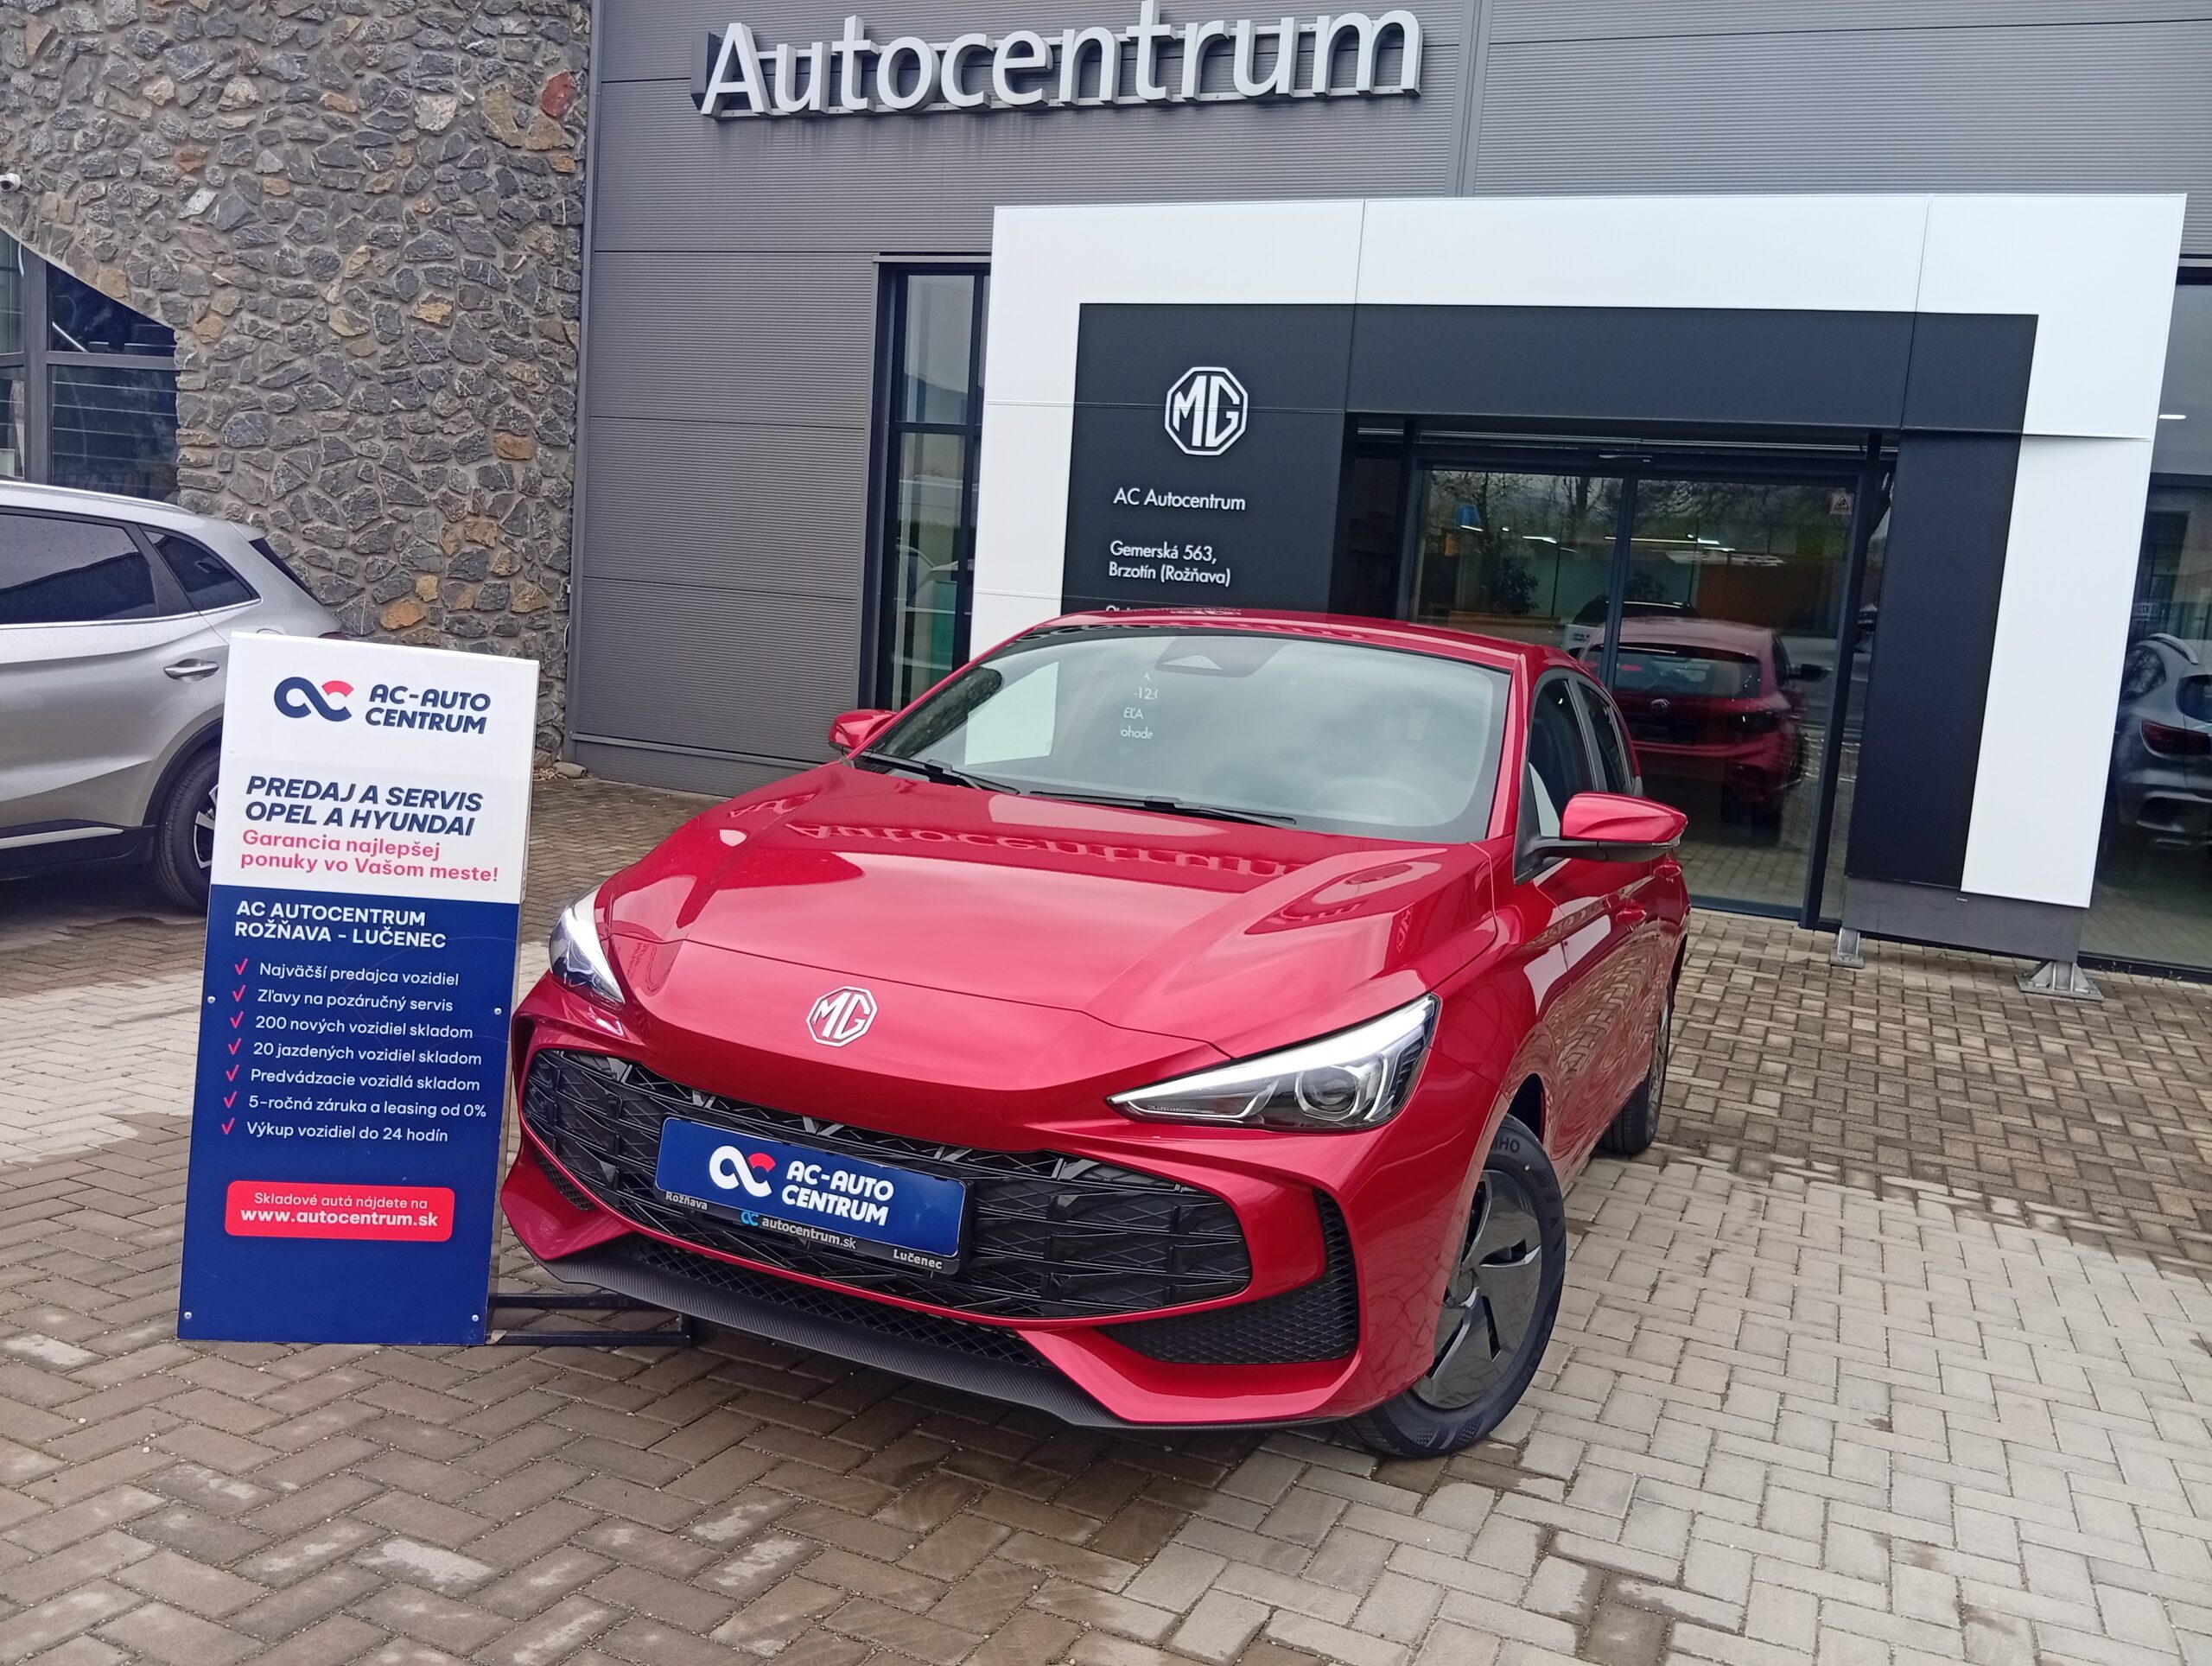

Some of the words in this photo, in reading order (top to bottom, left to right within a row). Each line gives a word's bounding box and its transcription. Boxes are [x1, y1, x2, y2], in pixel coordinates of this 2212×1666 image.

[700, 0, 1422, 117] Autocentrum
[1165, 366, 1249, 455] MG
[1113, 487, 1141, 506] AC
[1143, 489, 1246, 511] Autocentrum
[1109, 541, 1179, 560] Gemerská
[1182, 545, 1217, 564] 563,
[1109, 563, 1156, 580] Brzotín
[1160, 564, 1231, 588] (Rožňava)
[370, 684, 491, 712] AC-AUTO
[365, 707, 487, 734] CENTRUM
[246, 775, 357, 803] PREDAJ
[359, 785, 378, 804] A
[386, 786, 484, 811] SERVIS
[245, 802, 317, 825] OPEL
[324, 808, 343, 827] A
[350, 810, 475, 836] HYUNDAI
[242, 830, 341, 852] Garancia
[346, 839, 441, 861] najlepšej
[240, 855, 318, 873] ponuky
[324, 860, 347, 872] vo
[354, 857, 424, 877] Vašom
[430, 867, 499, 881] meste!
[237, 900, 266, 918] AC
[270, 903, 426, 926] AUTOCENTRUM
[235, 918, 332, 942] ROŽŇAVA
[353, 925, 446, 949] LUČENEC
[259, 962, 327, 982] Najväčší
[330, 968, 398, 983] predajca
[402, 970, 459, 987] vozidiel
[257, 989, 300, 1006] Zľavy
[304, 994, 323, 1006] na
[327, 994, 407, 1011] pozáručný
[410, 999, 454, 1013] servis
[256, 1015, 287, 1030] 200
[290, 1018, 345, 1035] nových
[349, 1021, 406, 1036] vozidiel
[410, 1025, 474, 1040] skladom
[805, 986, 878, 1047] MG
[253, 1042, 274, 1056] 20
[276, 1043, 354, 1061] jazdených
[358, 1048, 416, 1063] vozidiel
[418, 1051, 482, 1065] skladom
[251, 1068, 355, 1086] Predvádzacie
[359, 1075, 413, 1089] vozidlá
[416, 1077, 480, 1092] skladom
[249, 1095, 313, 1111] 5-ročná
[316, 1097, 366, 1113] záruka
[371, 1103, 380, 1114] a
[384, 1100, 437, 1118] leasing
[441, 1103, 460, 1116] od
[463, 1103, 486, 1118] 0%
[246, 1121, 294, 1139] Výkup
[297, 1124, 355, 1139] vozidiel
[359, 1126, 378, 1140] do
[383, 1127, 403, 1141] 24
[406, 1127, 448, 1142] hodín
[786, 1160, 893, 1202] AC-AUTO
[254, 1192, 317, 1206] Skladové
[321, 1194, 353, 1207] autá
[355, 1195, 408, 1209] nájdete
[411, 1199, 428, 1209] na
[782, 1185, 889, 1227] CENTRUM
[240, 1209, 438, 1228] www.autocentrum.sk
[762, 1217, 856, 1250] autocentrum.sk
[893, 1249, 943, 1270] Lučenec
